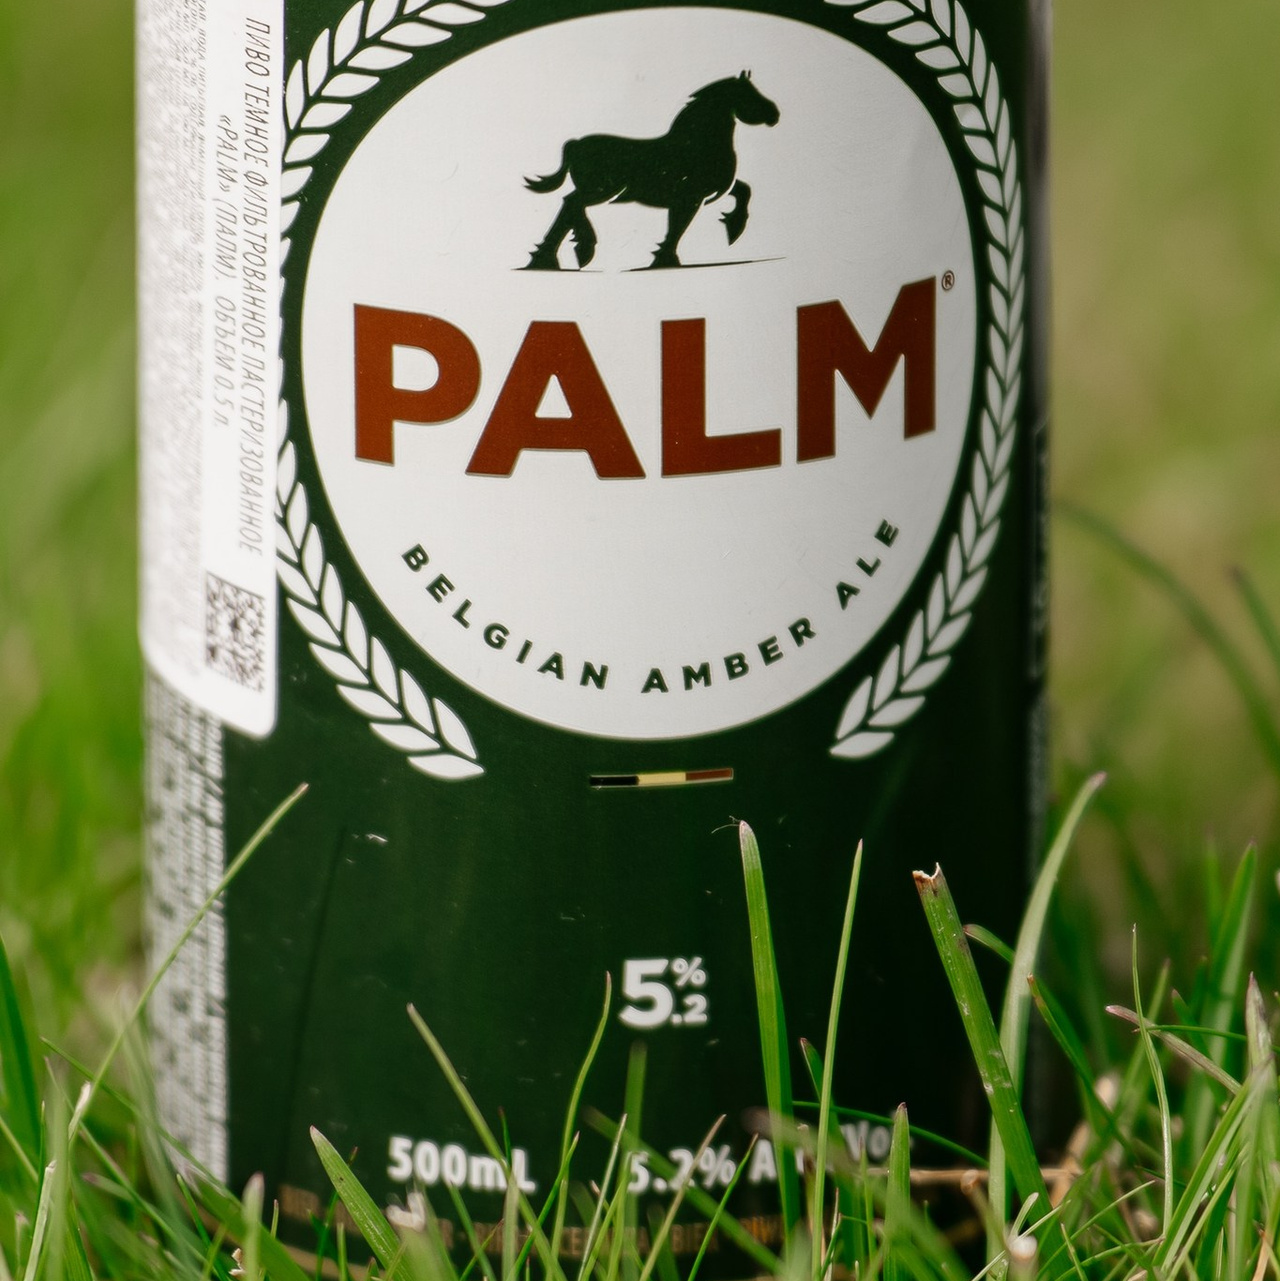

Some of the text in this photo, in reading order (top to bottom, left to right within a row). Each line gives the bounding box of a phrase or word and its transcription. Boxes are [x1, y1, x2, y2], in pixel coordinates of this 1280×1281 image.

[213, 295, 236, 372] ОБЪЕМ
[239, 17, 271, 556] ПИВО ТЕМНОЕ ФИЛЬТРОВАННОЕ ПАСТЕРИЗОВАННОЕ
[354, 276, 936, 480] PALM
[401, 519, 899, 694] BELGIAN AMBER ALE
[387, 1135, 537, 1195] 500mL
[627, 1145, 737, 1195] 5.2%
